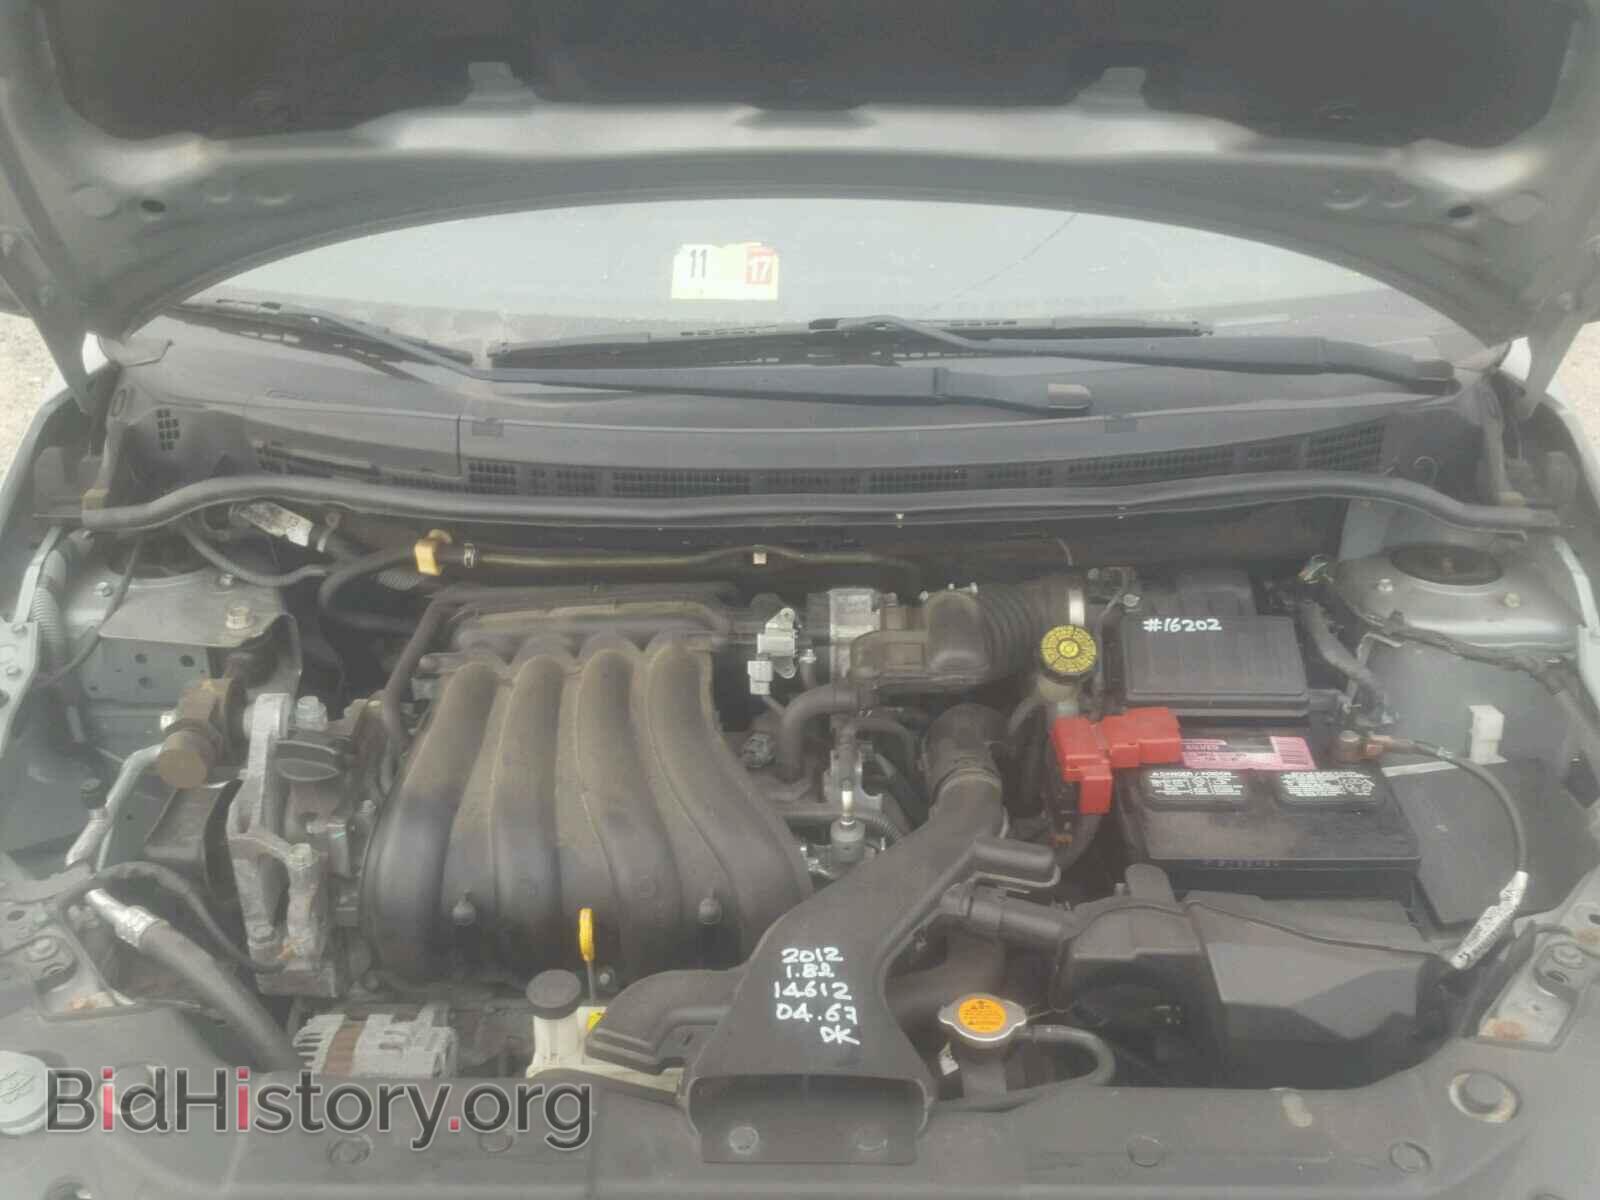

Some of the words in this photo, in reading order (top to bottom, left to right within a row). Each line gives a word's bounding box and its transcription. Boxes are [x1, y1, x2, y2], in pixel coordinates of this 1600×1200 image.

[690, 249, 707, 278] 11
[750, 258, 770, 283] 17
[1142, 617, 1222, 633] #16202
[781, 947, 844, 963] 2012
[774, 980, 852, 1000] 14612
